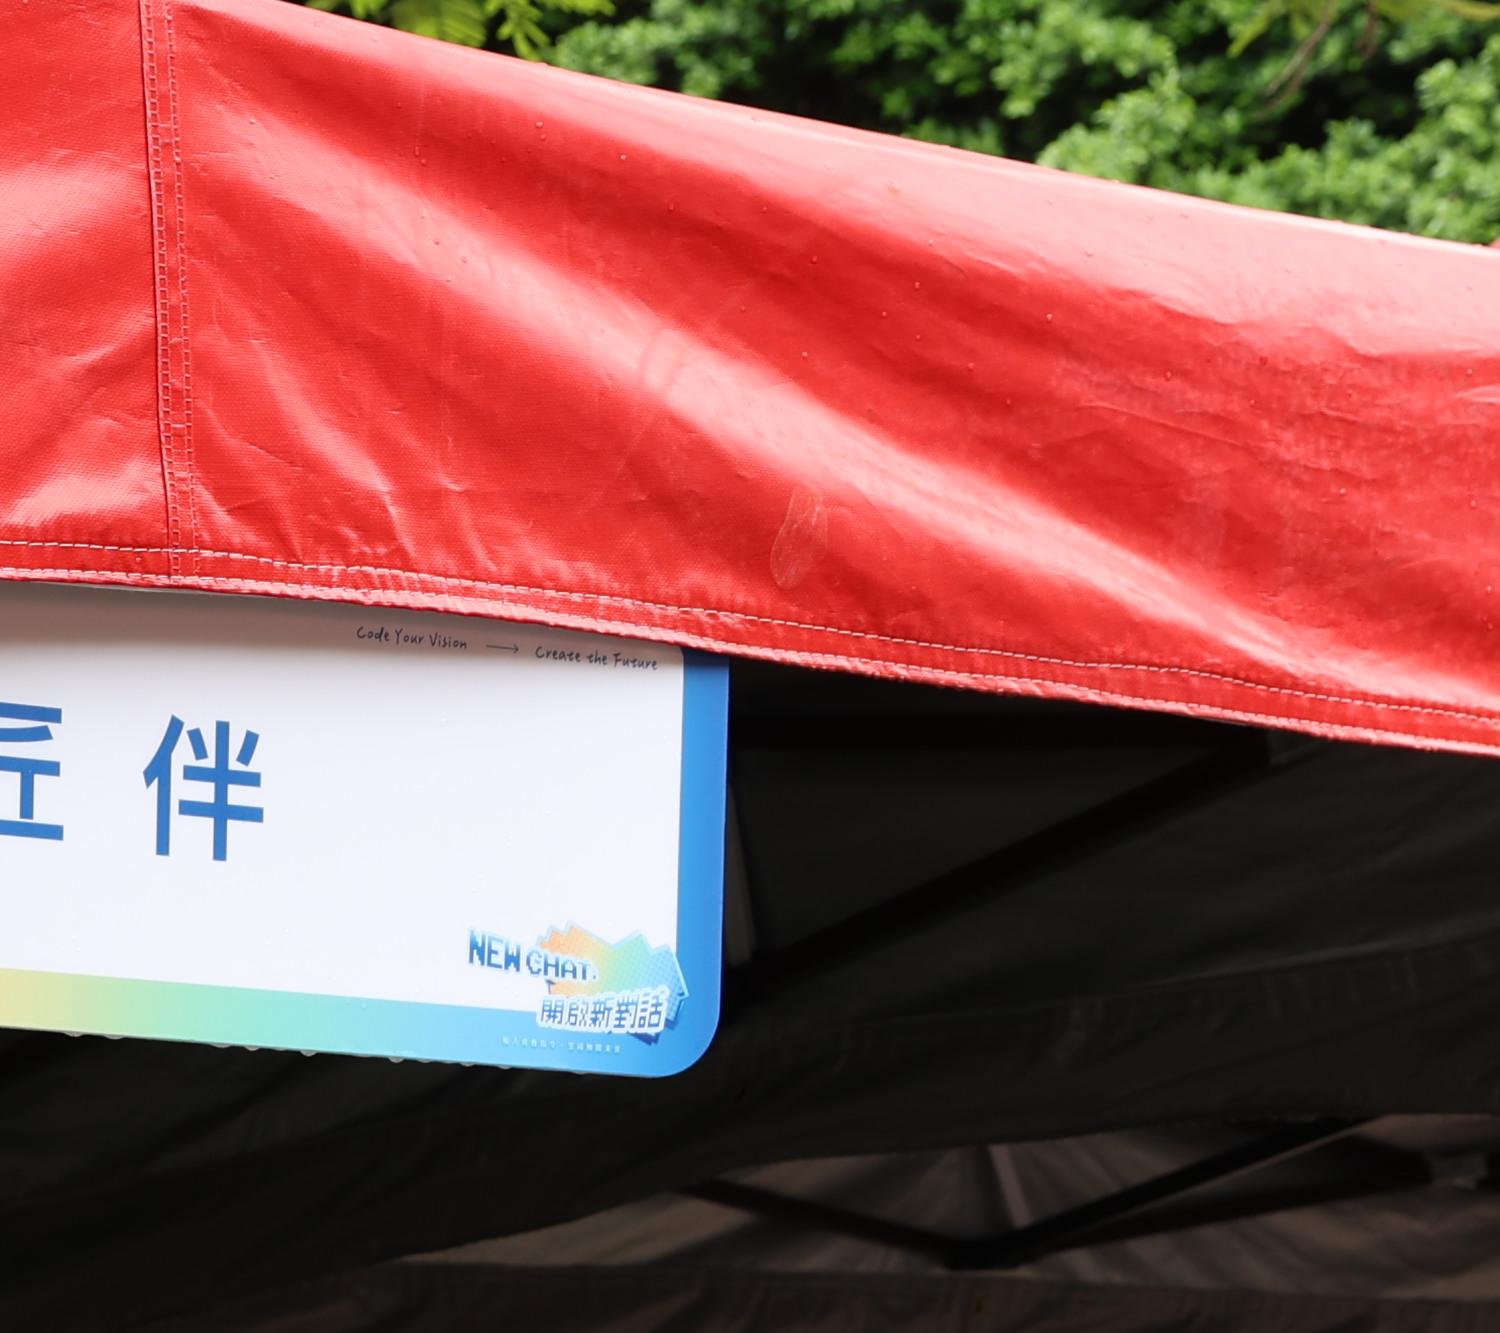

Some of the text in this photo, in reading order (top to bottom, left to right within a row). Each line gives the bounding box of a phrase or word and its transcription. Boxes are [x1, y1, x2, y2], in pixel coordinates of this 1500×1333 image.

[356, 626, 659, 671] Code Your Vision Create the Future
[468, 928, 521, 973] NEW
